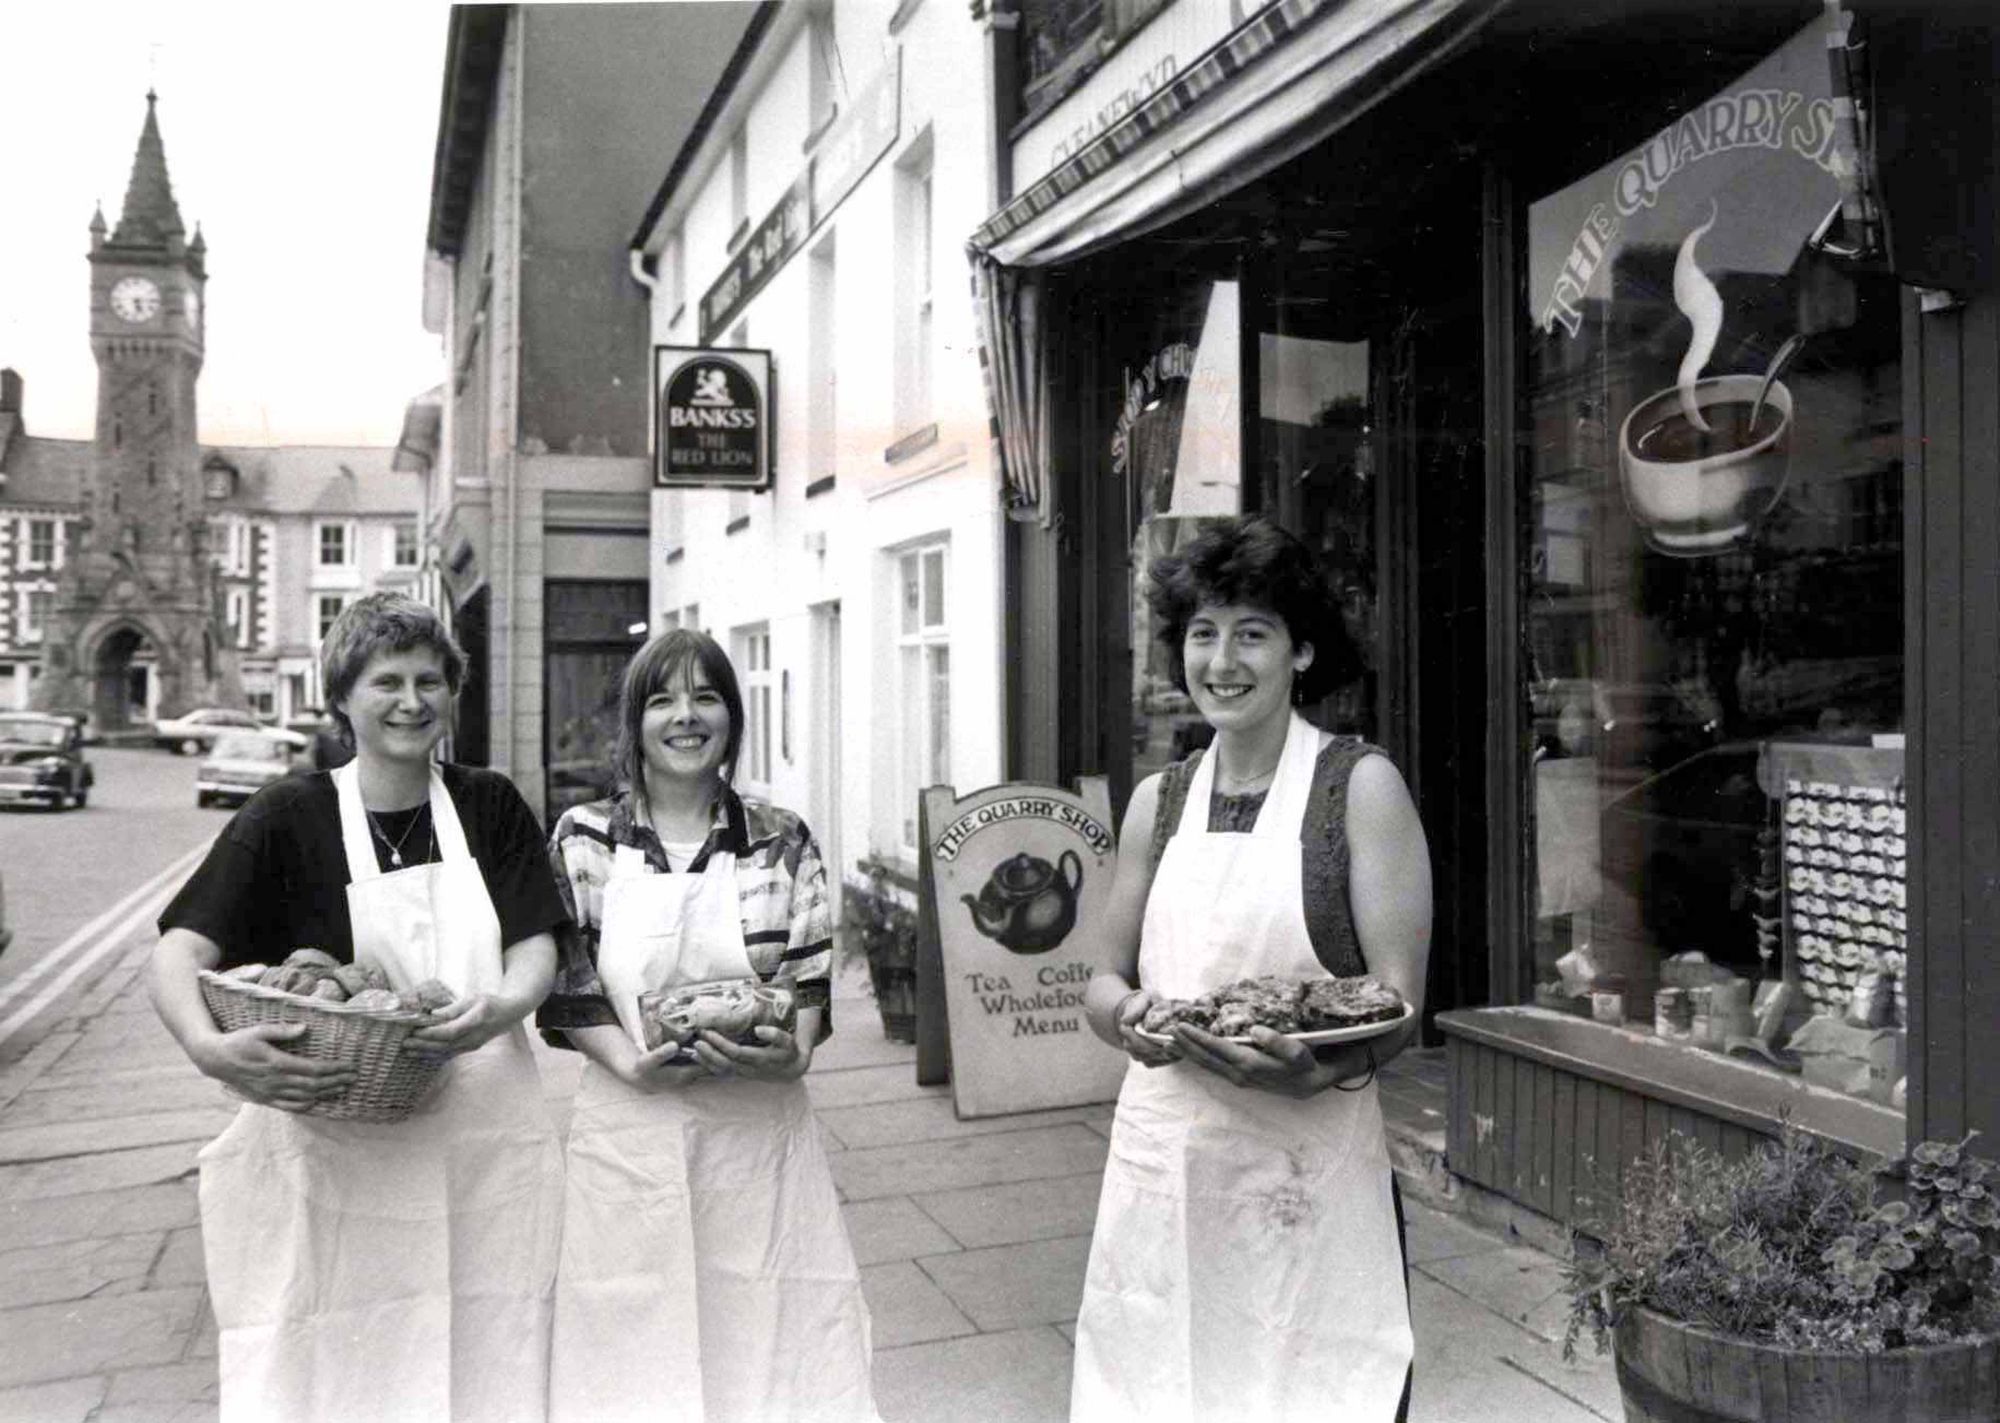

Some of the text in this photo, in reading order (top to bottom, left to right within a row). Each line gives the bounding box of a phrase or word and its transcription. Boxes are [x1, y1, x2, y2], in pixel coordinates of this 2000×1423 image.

[1543, 202, 1620, 338] THE
[1614, 89, 1802, 216] QUARRY
[672, 448, 753, 466] RED LION
[936, 800, 1111, 856] THE QUARRY SHOP
[964, 972, 1012, 993] Tea
[1013, 1017, 1079, 1037] Menu
